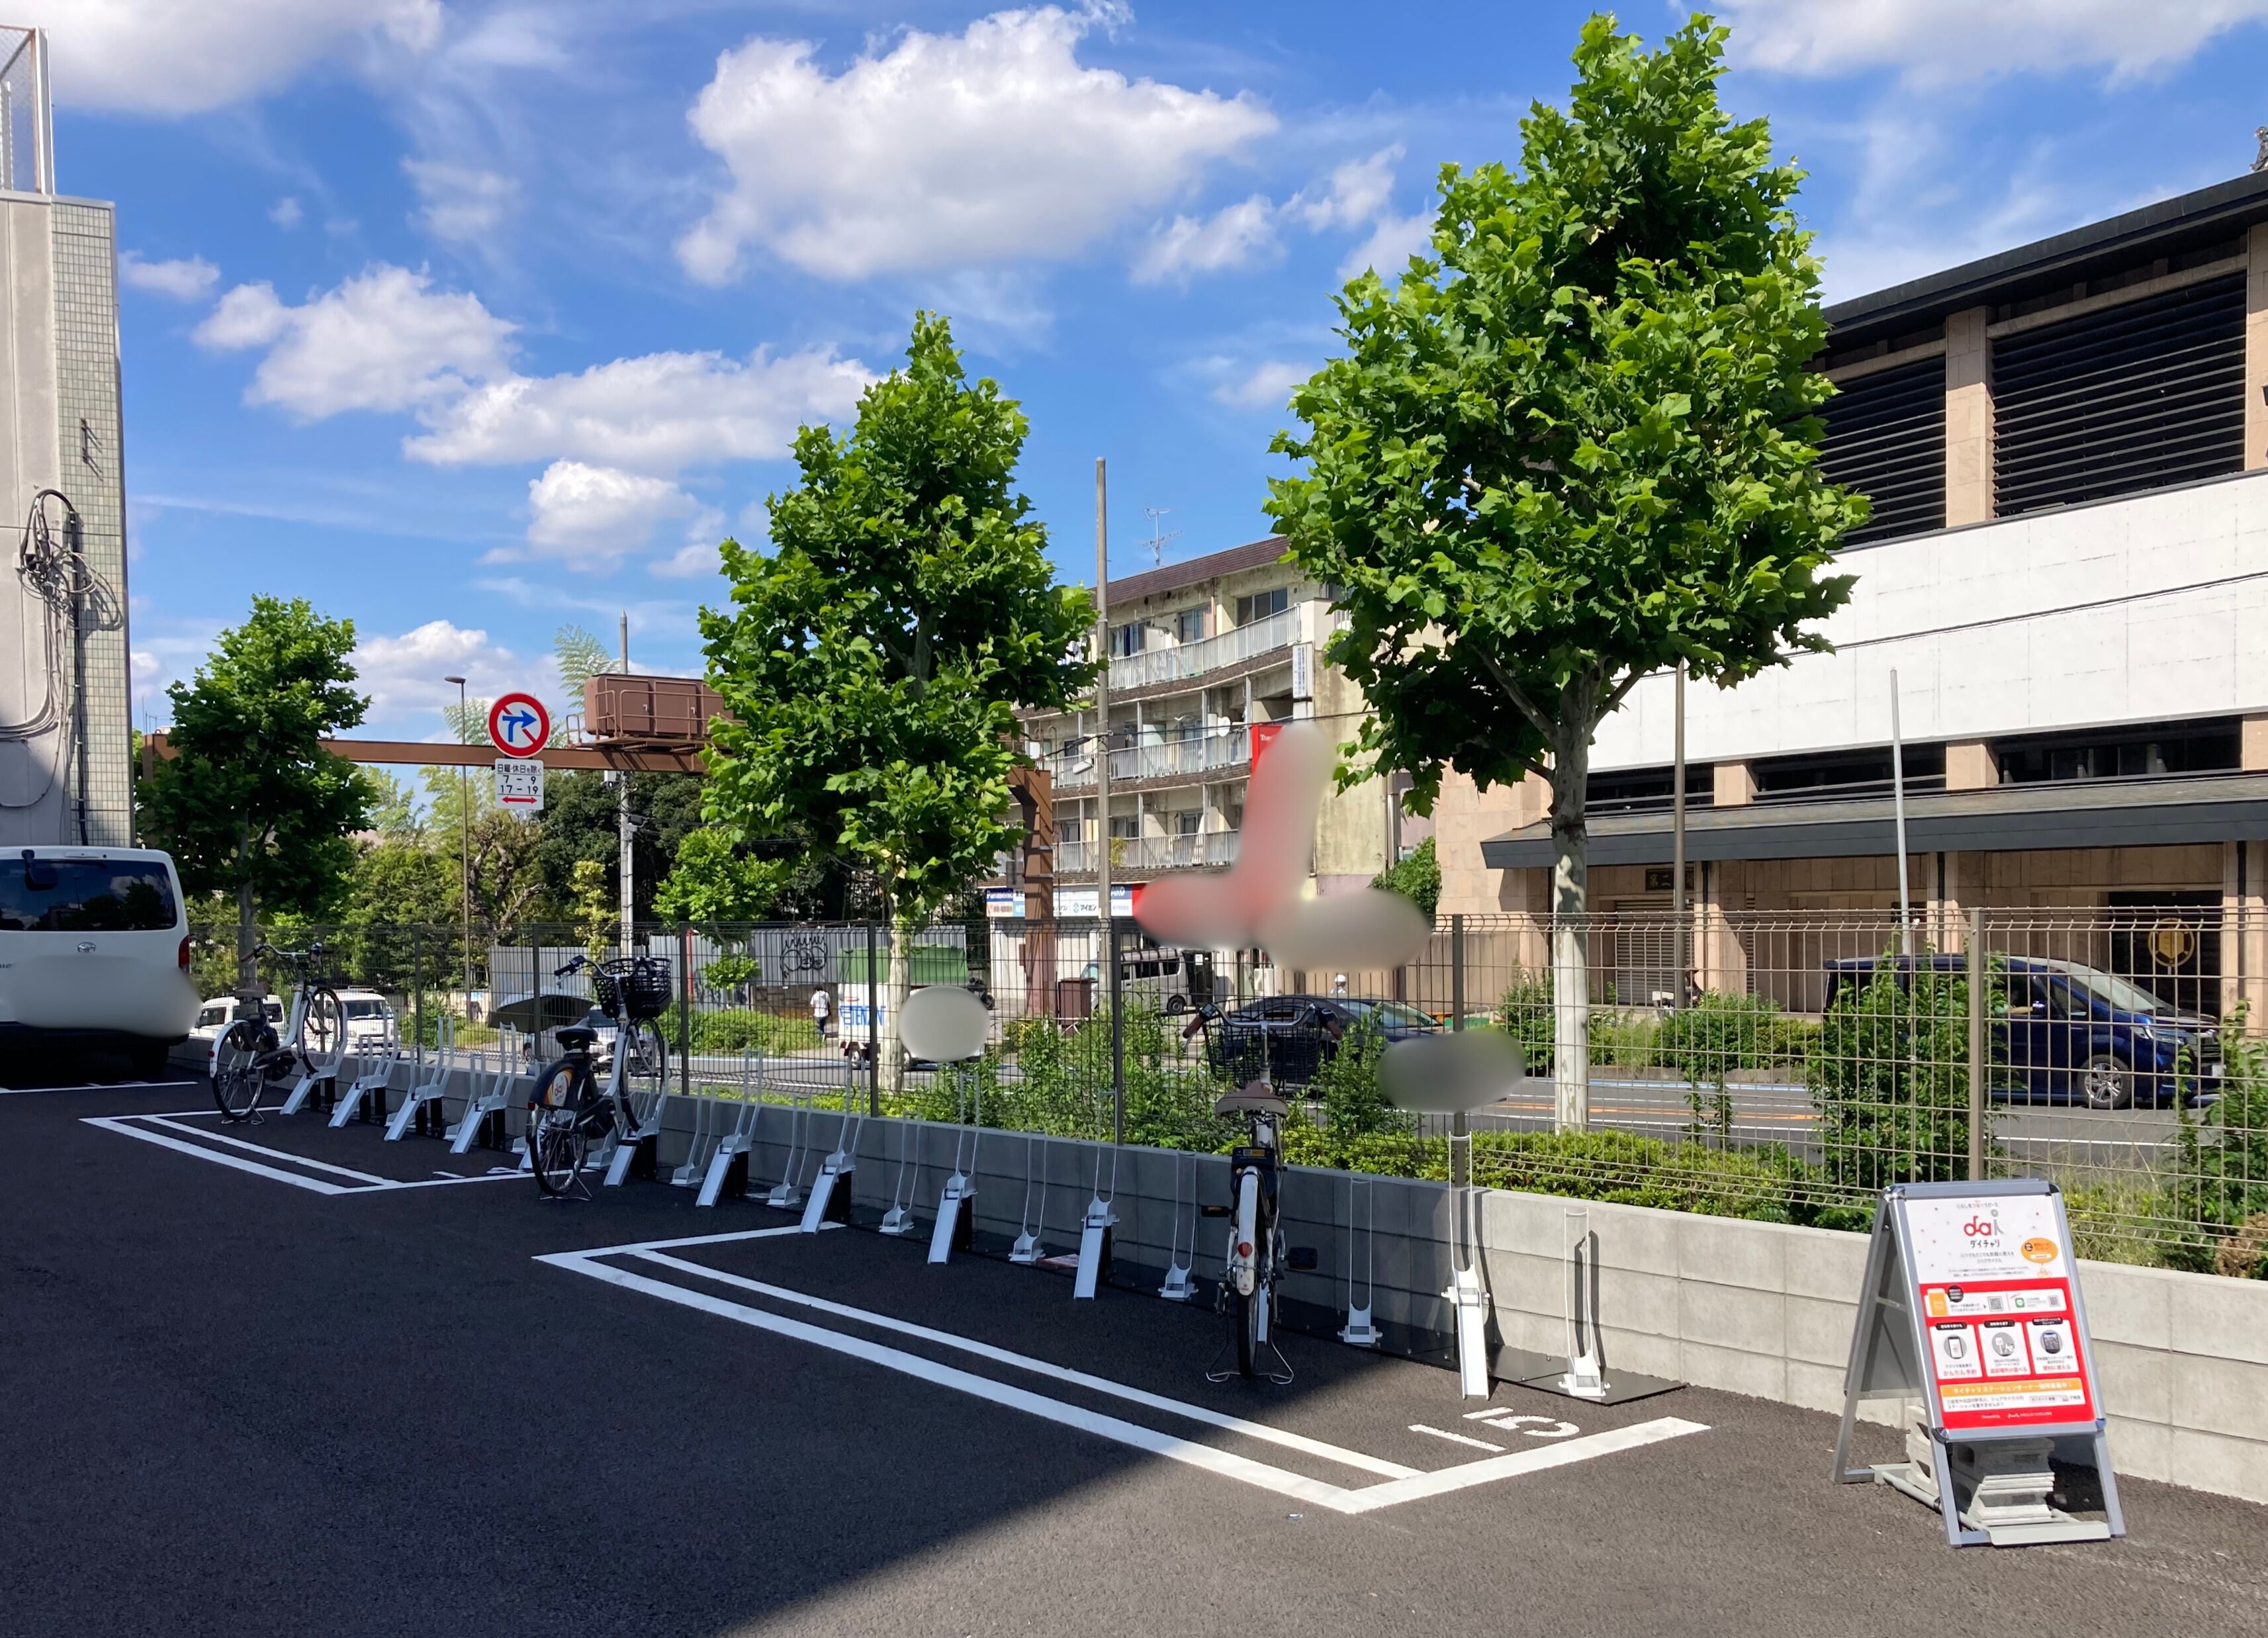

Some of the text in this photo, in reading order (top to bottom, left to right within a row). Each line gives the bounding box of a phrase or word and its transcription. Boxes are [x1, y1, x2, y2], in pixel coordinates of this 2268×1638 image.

[1970, 1239, 2000, 1248] ダイチャリ
[1408, 1407, 1580, 1452] 15
